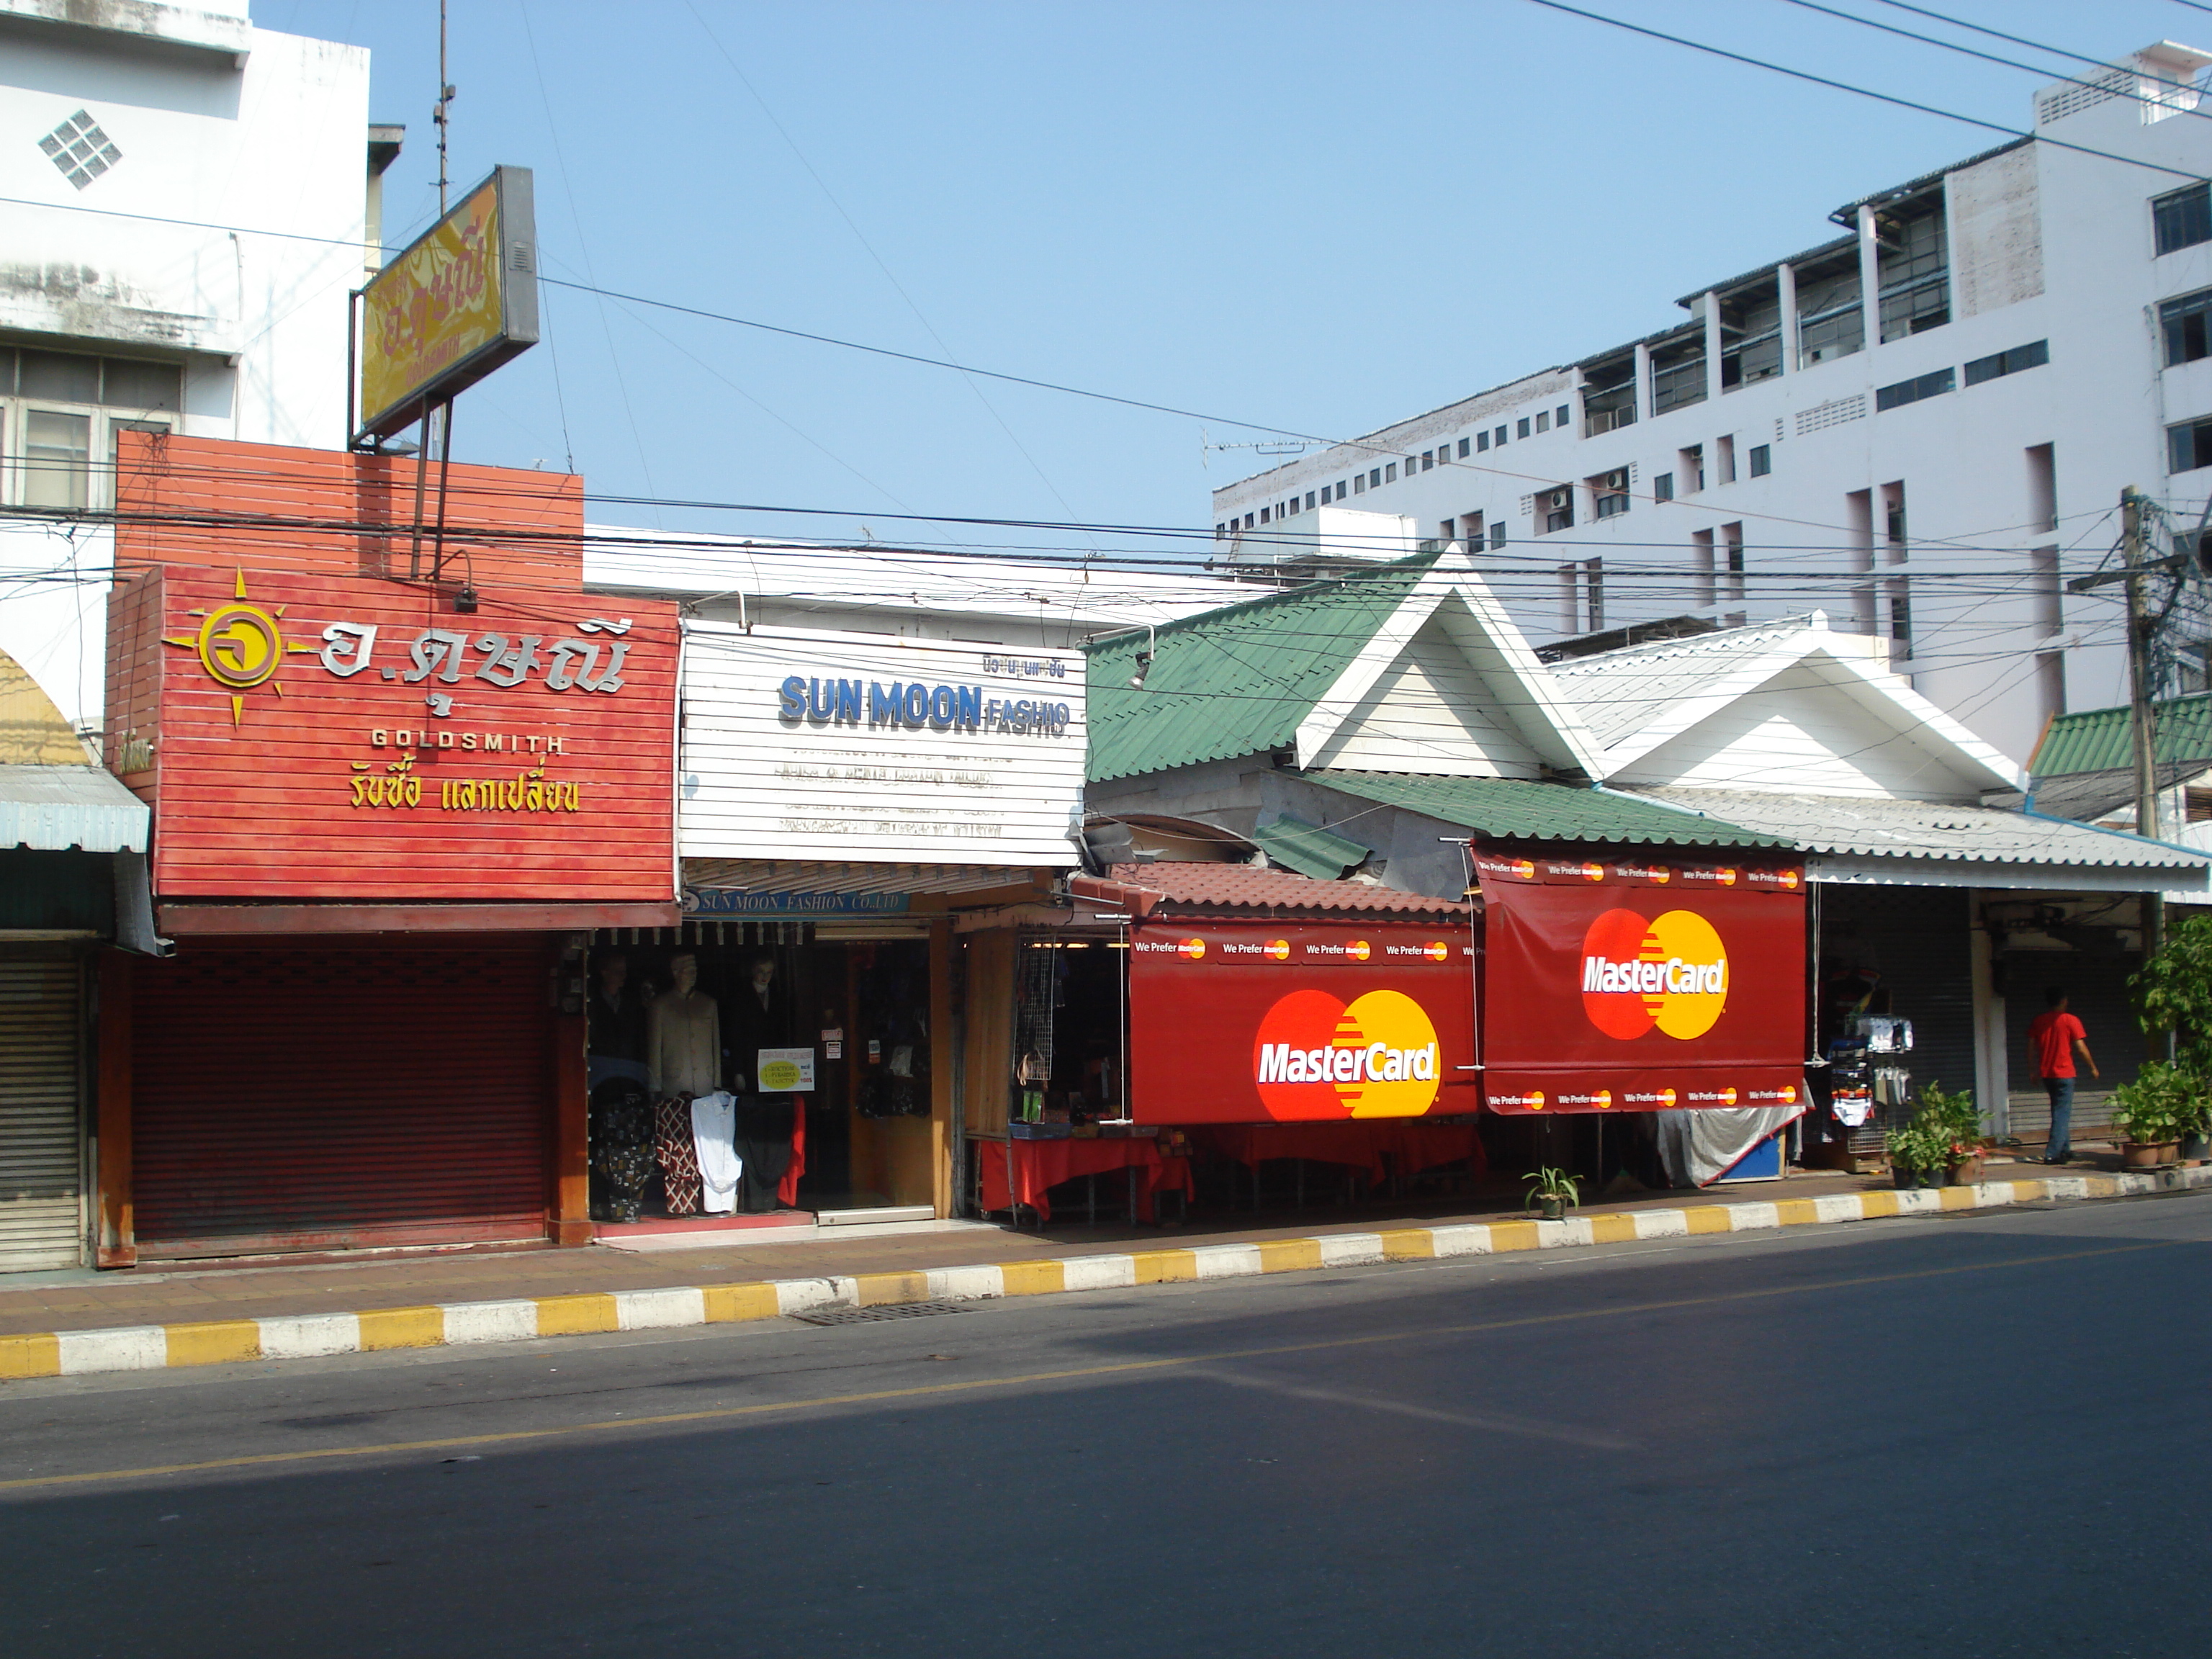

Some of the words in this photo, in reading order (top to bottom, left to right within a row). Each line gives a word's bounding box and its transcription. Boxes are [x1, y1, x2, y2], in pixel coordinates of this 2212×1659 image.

[781, 676, 863, 720] SUN
[870, 682, 981, 727] MOON
[988, 698, 1070, 727] FASHIO
[371, 728, 563, 754] GOLDSMITH
[350, 752, 422, 809] รับซื้อ
[441, 756, 580, 812] แลกเปลี่ยน
[1491, 863, 1510, 872] Prefer
[1561, 866, 1581, 875] Prefer
[703, 895, 730, 909] SUN
[734, 896, 779, 910] MOON
[787, 895, 844, 910] FASHION
[1135, 942, 1149, 952] We
[1151, 943, 1177, 952] Prefer
[1223, 944, 1237, 953] We
[1238, 944, 1262, 953] Prefer
[1306, 945, 1320, 954] We
[1321, 945, 1344, 954] Prefer
[1386, 945, 1399, 955] We
[1401, 946, 1423, 955] Prefer
[1582, 956, 1725, 994] MasterCard
[1258, 1042, 1435, 1083] MasterCard
[1489, 1096, 1501, 1105] We
[1501, 1096, 1521, 1105] Prefer
[1558, 1095, 1570, 1104] We
[1570, 1094, 1590, 1103] Prefer
[1624, 1093, 1635, 1102] We
[1637, 1093, 1656, 1102] Prefer
